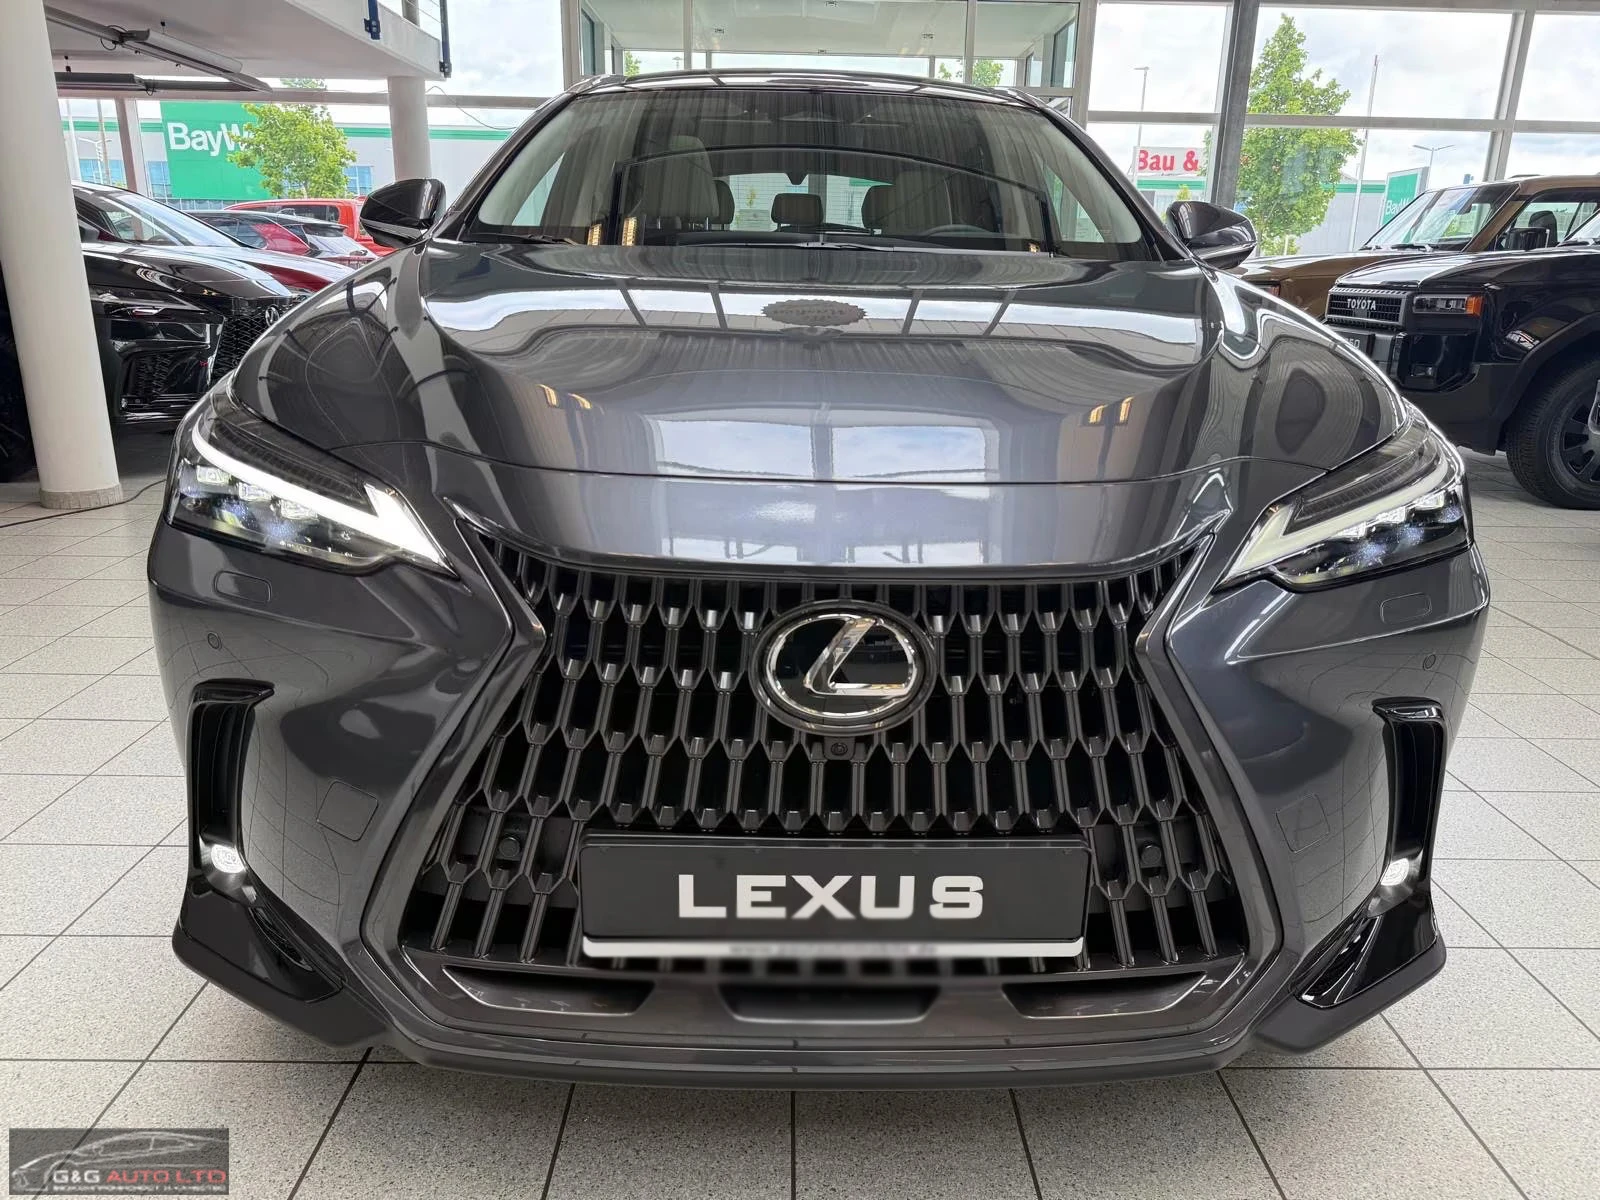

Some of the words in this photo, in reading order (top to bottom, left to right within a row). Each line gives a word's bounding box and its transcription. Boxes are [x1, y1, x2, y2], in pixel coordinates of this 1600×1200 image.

[167, 122, 264, 156] BayW
[1138, 149, 1175, 171] Bau
[1347, 298, 1376, 311] TOYOTA
[678, 873, 984, 920] LEXUS
